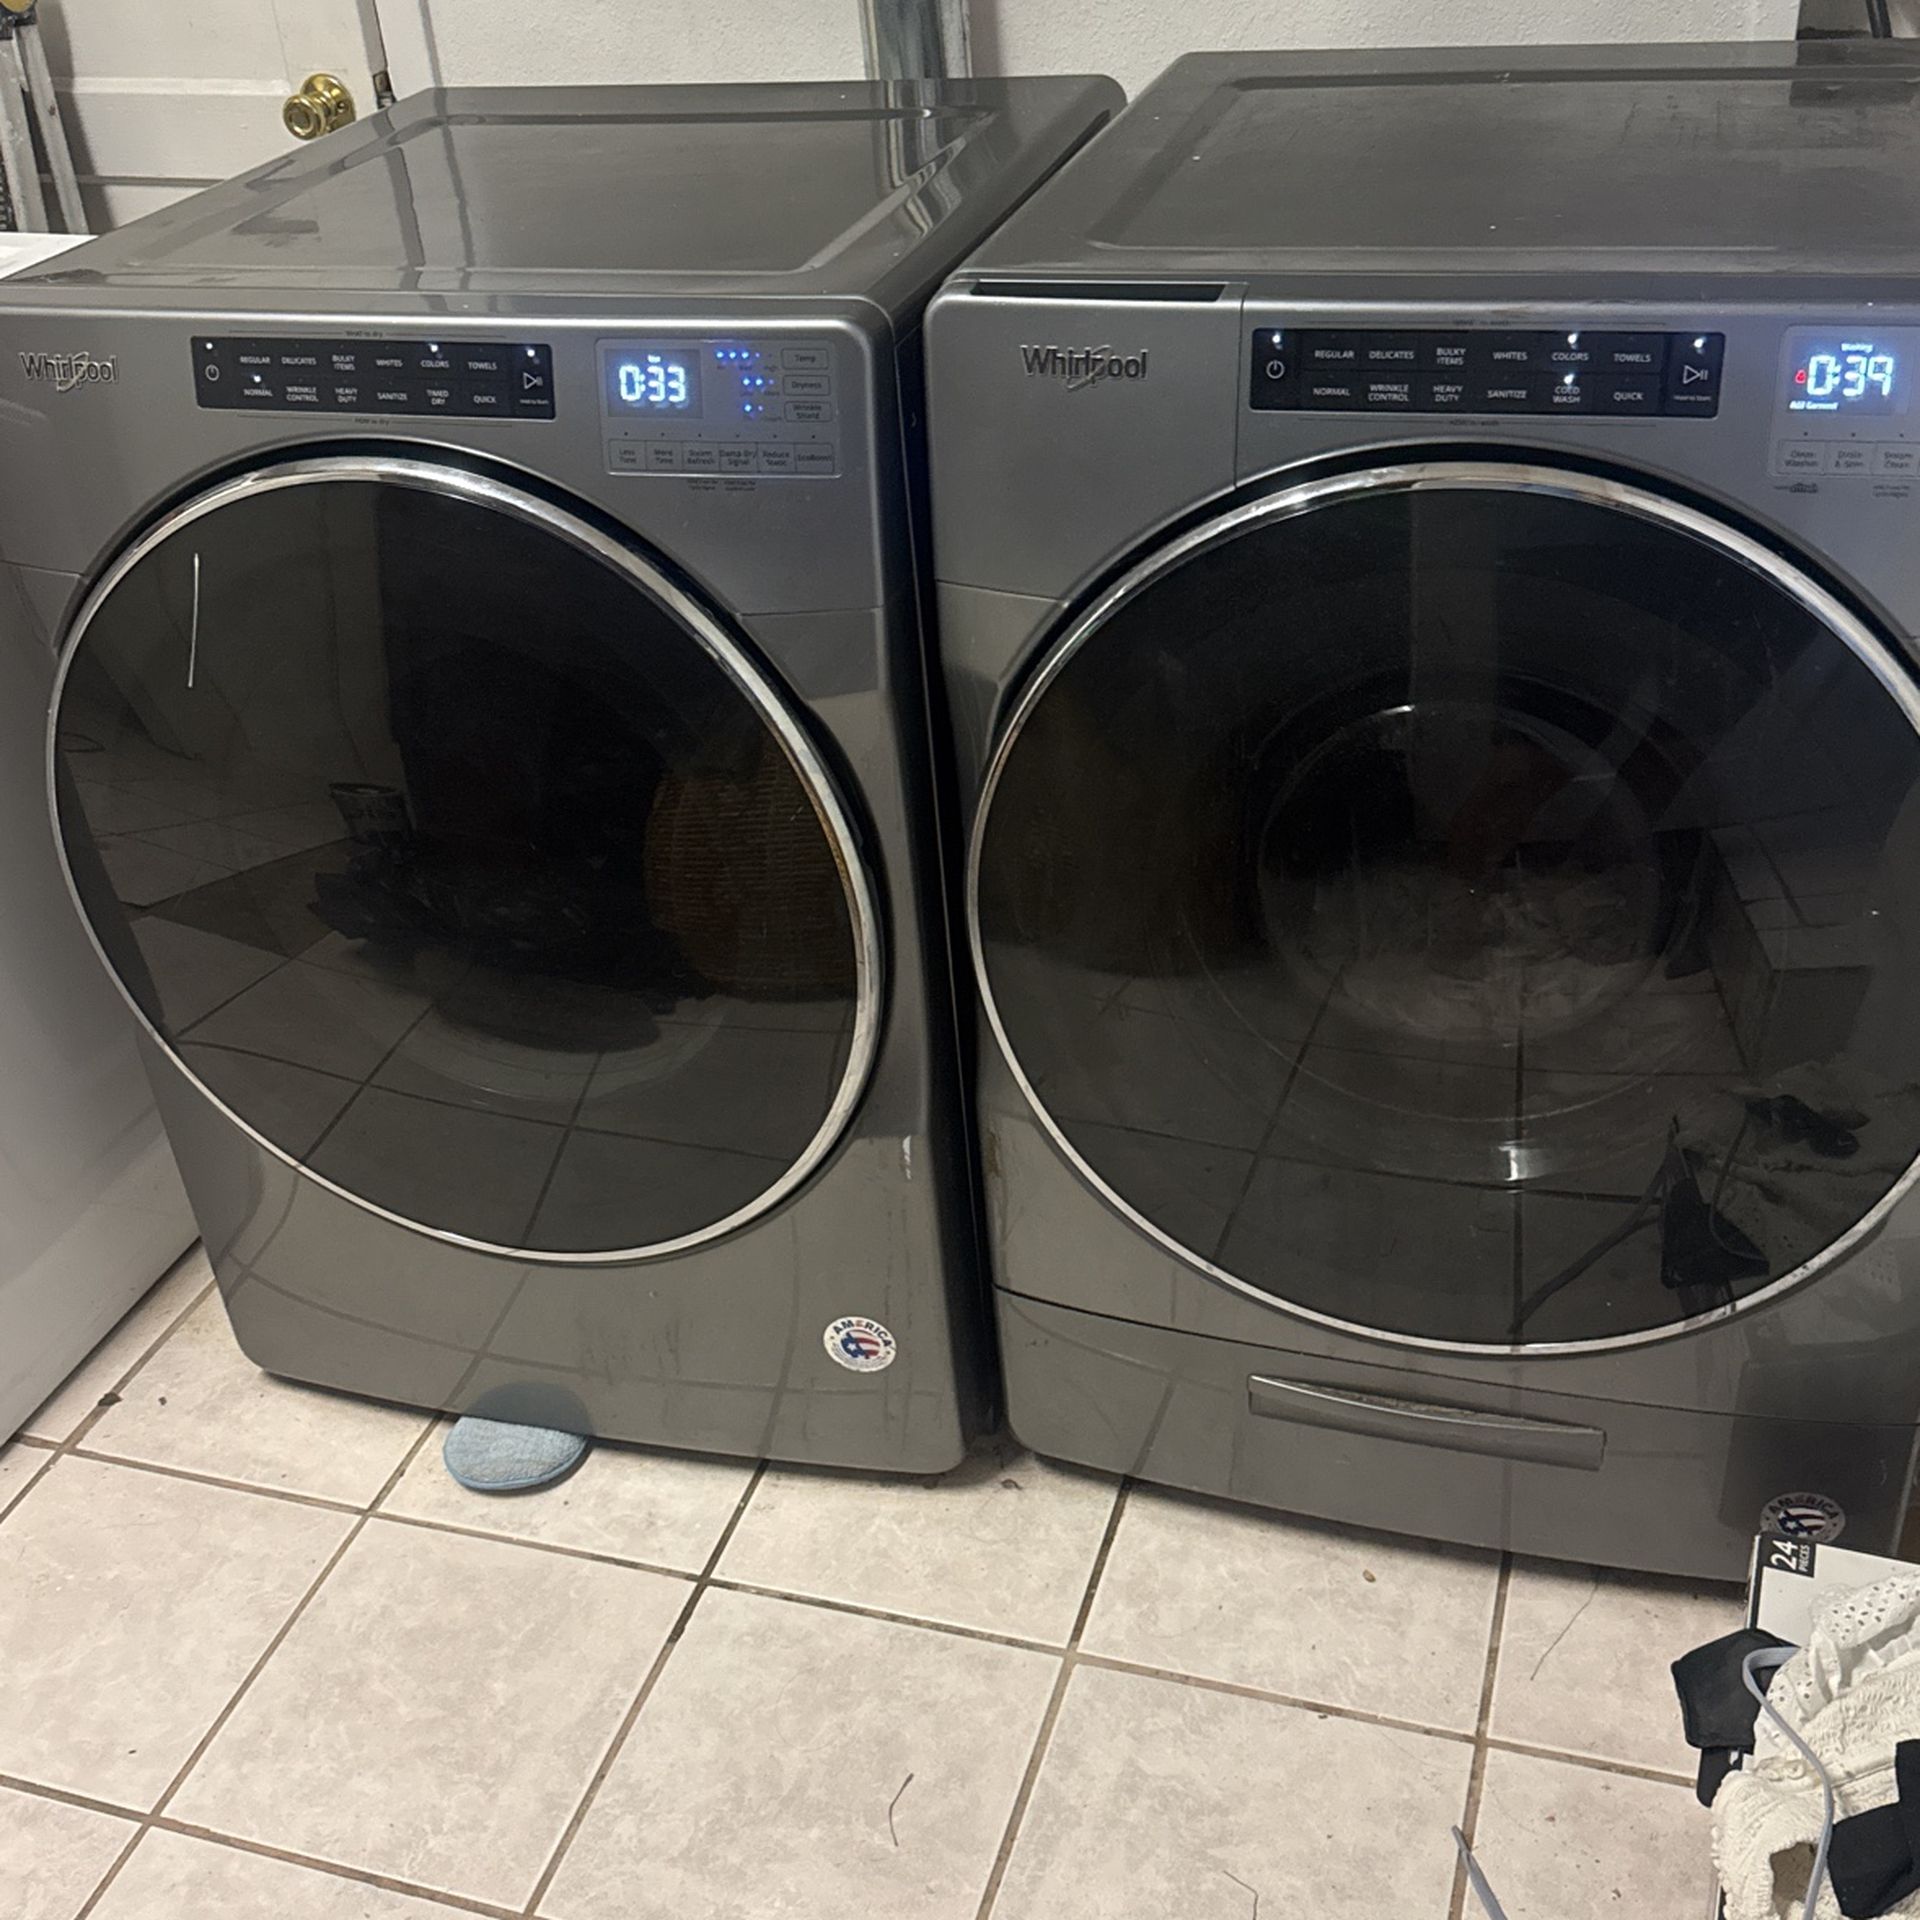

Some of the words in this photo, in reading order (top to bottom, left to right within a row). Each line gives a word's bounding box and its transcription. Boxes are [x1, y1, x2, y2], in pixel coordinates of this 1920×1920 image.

[1314, 350, 1354, 359] REGULAR
[1369, 351, 1414, 359] DELICATES
[1436, 348, 1466, 356] BULKY
[240, 356, 271, 364] REGULAR
[1493, 352, 1528, 361] WHITES
[1552, 353, 1589, 361] COLORS
[1613, 354, 1651, 362] TOWELS
[281, 357, 316, 365] DELICATES
[1437, 357, 1464, 365] ITEMS
[334, 363, 355, 371] ITEMS
[468, 362, 497, 370] TOWELS
[1020, 344, 1149, 392] Whirlpool
[19, 351, 119, 393] Whirlpool
[1807, 354, 1894, 397] 0:39
[618, 365, 686, 402] 0:33
[286, 386, 317, 394] WRINKLE
[1313, 388, 1350, 397] NORMAL
[1370, 384, 1409, 393] WRINKLE
[1433, 385, 1463, 393] HEAVY
[1554, 386, 1580, 394] COLD
[244, 389, 272, 397] NORMAL
[377, 392, 408, 401] SANITIZE
[1488, 390, 1527, 399] SANITIZE
[1613, 392, 1643, 400] QUICK
[286, 394, 319, 402] CONTROL
[338, 395, 356, 403] DUTY
[473, 395, 496, 404] QUICK
[1368, 393, 1409, 402] CONTROL
[1435, 394, 1460, 402] DUTY
[1553, 395, 1581, 403] WASH
[833, 1319, 893, 1347] AMERICA
[1768, 1494, 1840, 1519] AMERICA
[1770, 1540, 1798, 1570] 24
[1798, 1544, 1810, 1572] PIECES
